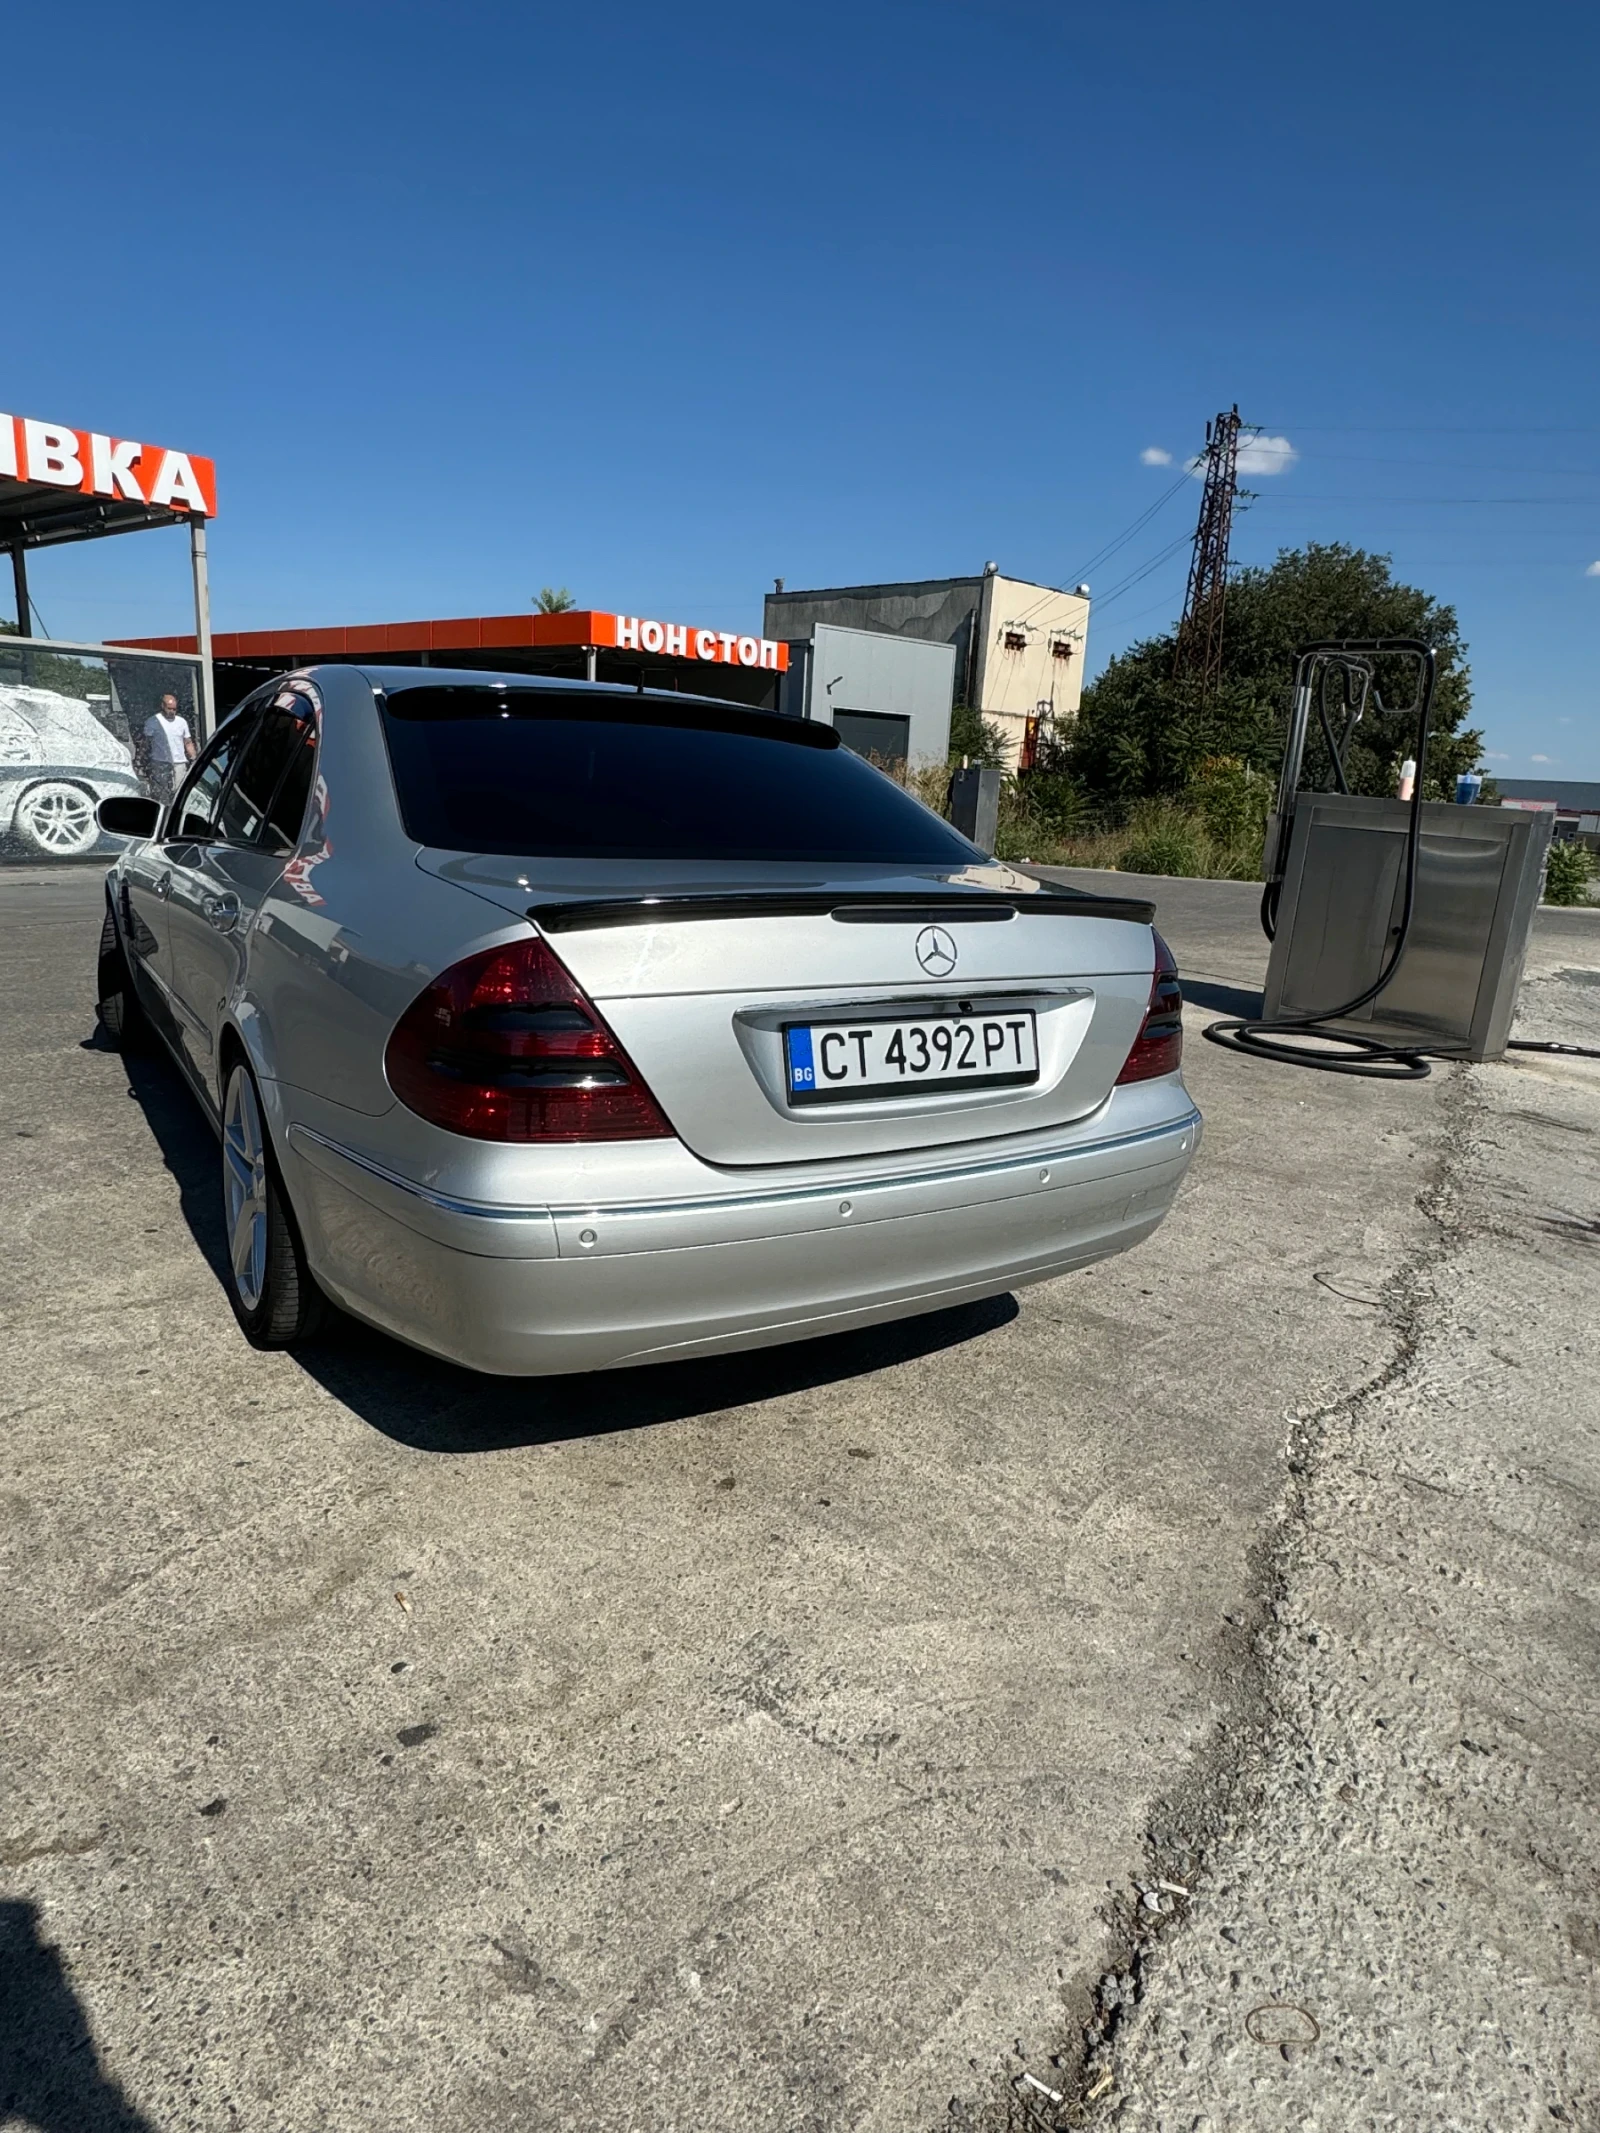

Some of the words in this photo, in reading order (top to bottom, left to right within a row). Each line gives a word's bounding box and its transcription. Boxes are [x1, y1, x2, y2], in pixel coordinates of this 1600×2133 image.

[617, 616, 687, 656] НОН
[696, 630, 778, 669] СТОП
[794, 1068, 812, 1082] BG
